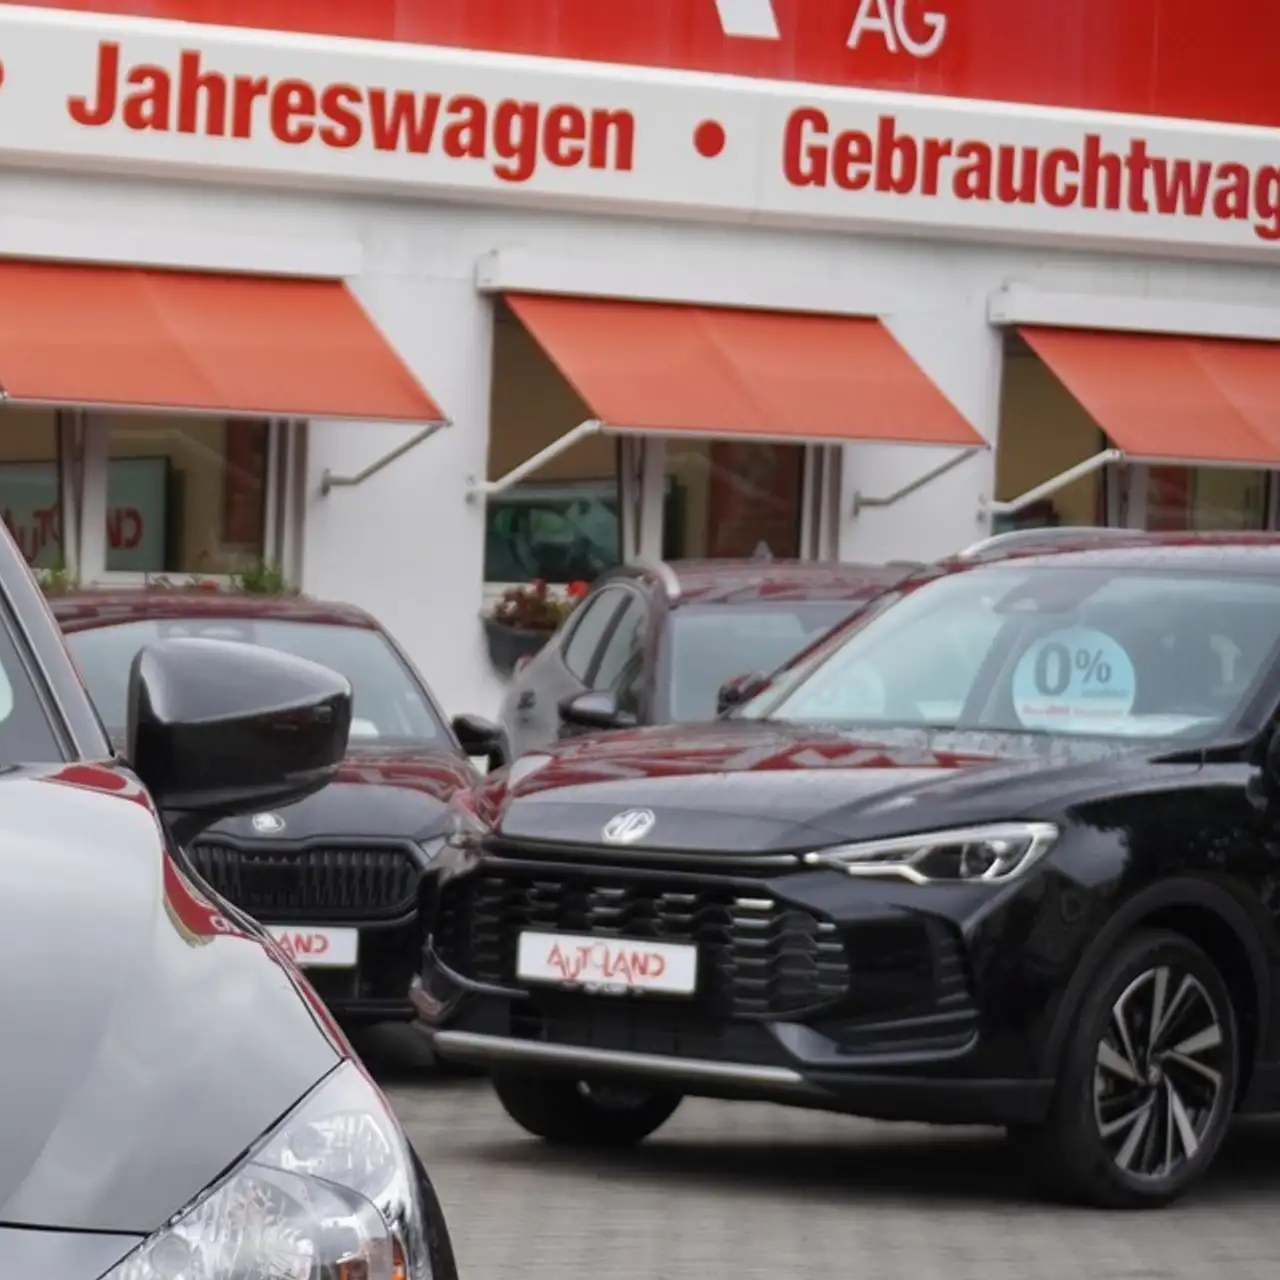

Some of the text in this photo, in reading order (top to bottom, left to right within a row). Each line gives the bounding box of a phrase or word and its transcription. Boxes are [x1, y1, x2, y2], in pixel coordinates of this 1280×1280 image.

[846, 0, 946, 58] AG
[67, 42, 636, 182] Jahreswagen
[1034, 641, 1113, 697] 0%
[546, 941, 666, 984] AUTOLAND
